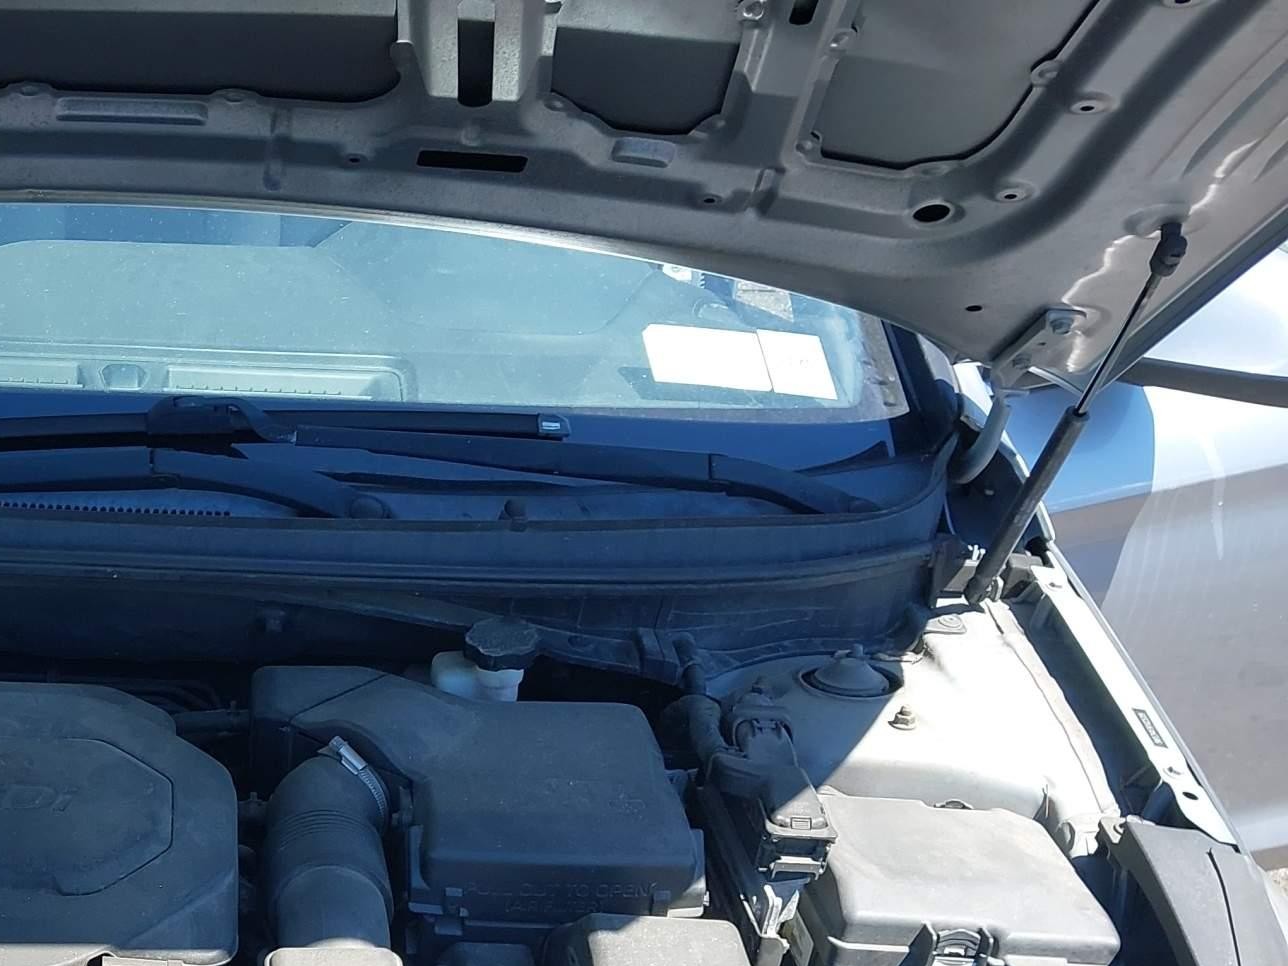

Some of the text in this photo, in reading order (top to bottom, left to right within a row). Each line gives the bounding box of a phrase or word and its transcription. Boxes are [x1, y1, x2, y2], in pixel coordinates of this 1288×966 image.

[519, 882, 560, 897] OUT
[567, 883, 591, 897] TO
[595, 883, 649, 898] OPEN
